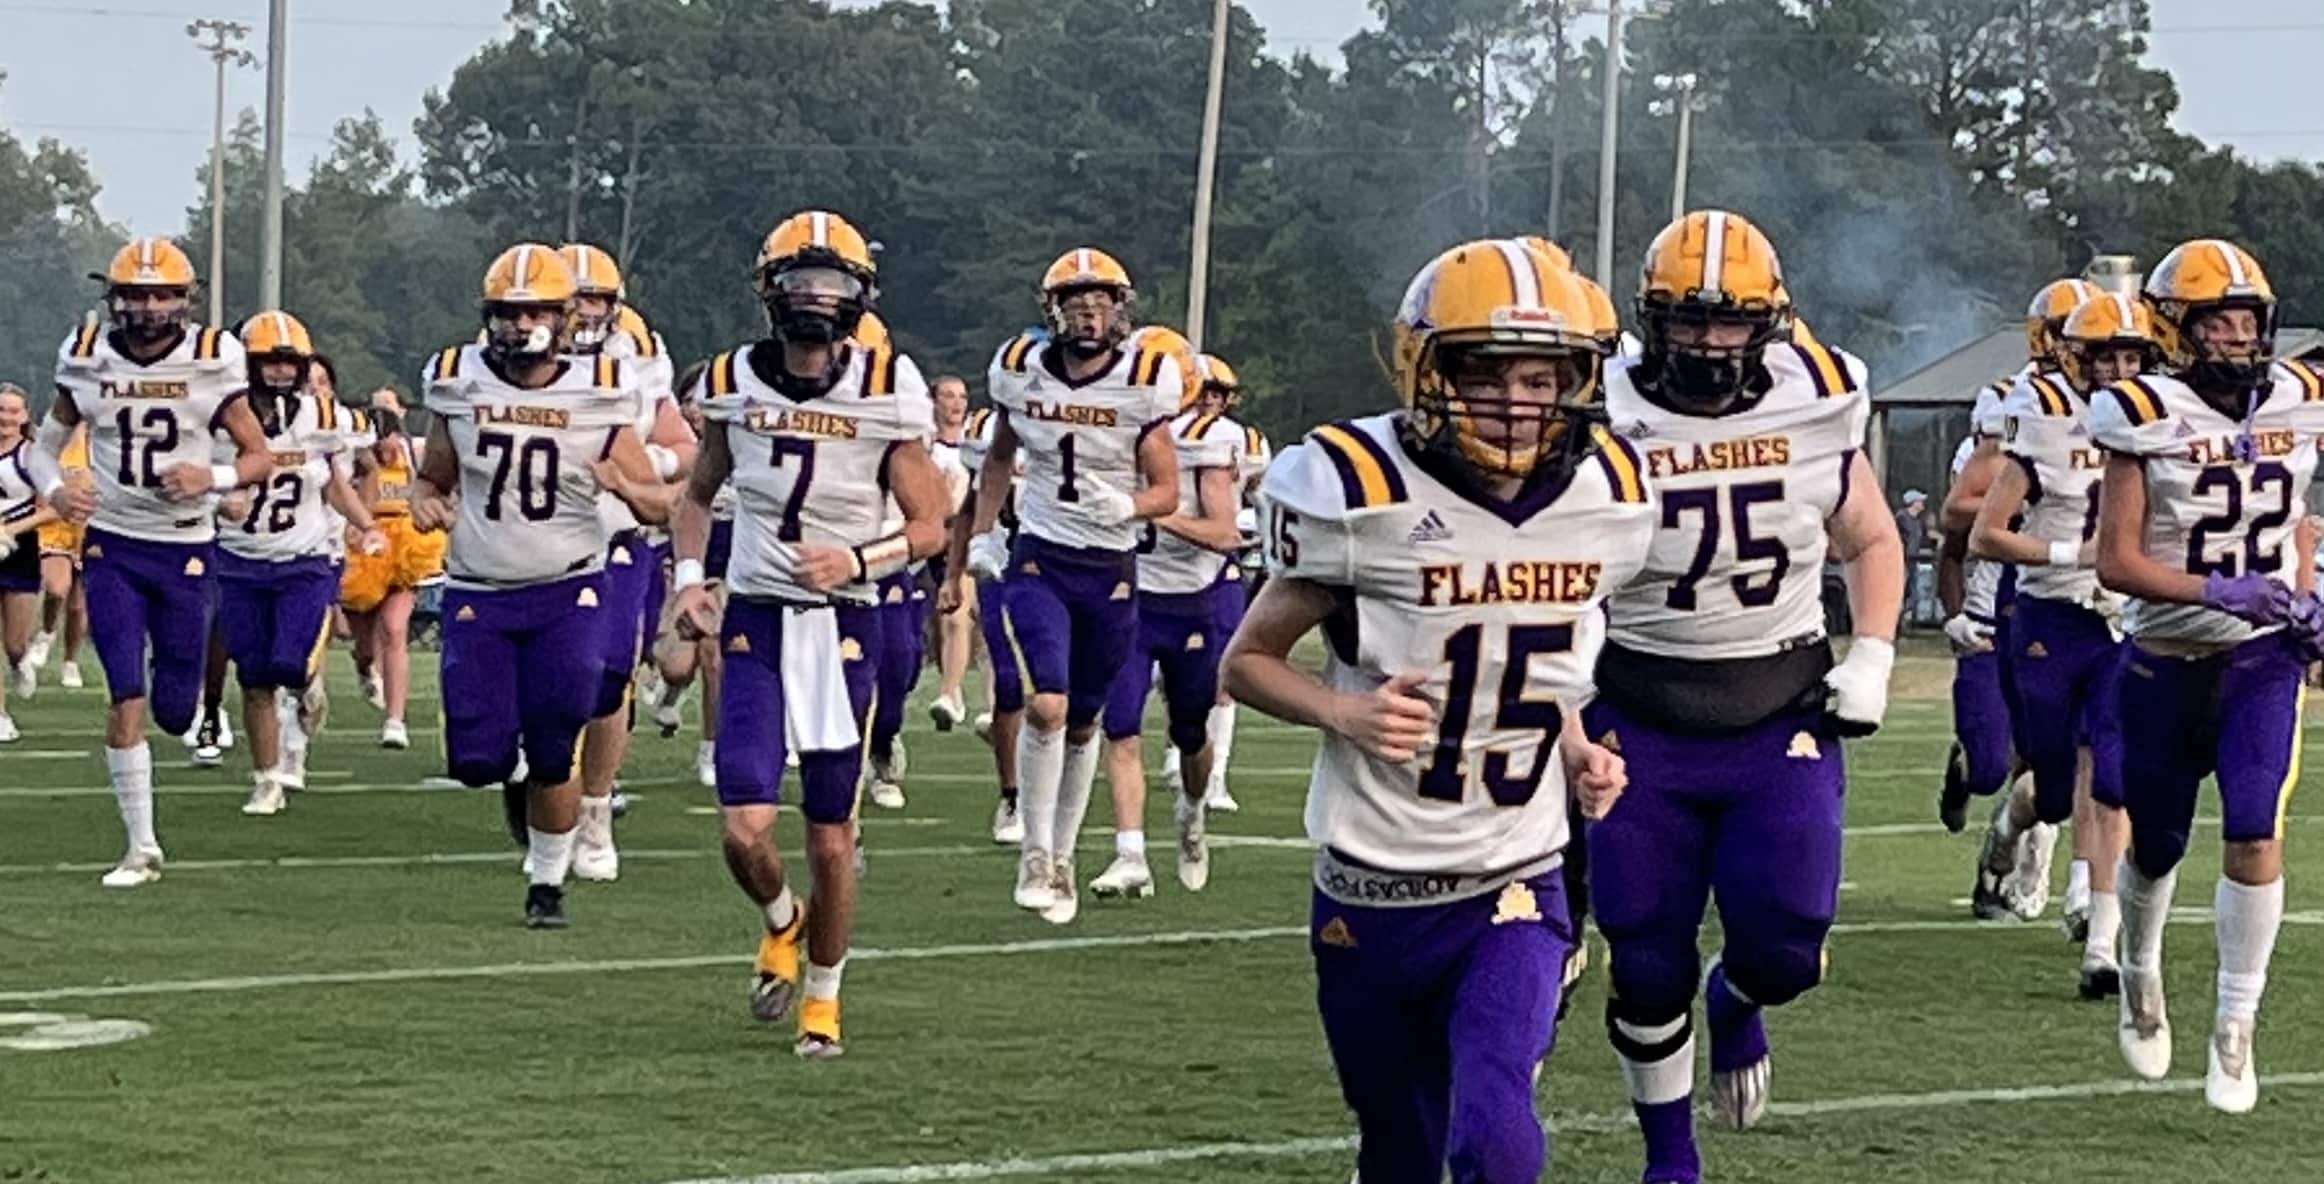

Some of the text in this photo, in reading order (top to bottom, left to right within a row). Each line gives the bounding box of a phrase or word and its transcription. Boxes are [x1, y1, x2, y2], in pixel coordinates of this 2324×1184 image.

[116, 405, 180, 488] 12
[473, 405, 570, 429] FLASHES
[744, 409, 858, 438] FLASHES
[1024, 401, 1117, 427] FLASHES
[475, 431, 560, 522] 70
[769, 435, 815, 542] 7
[1057, 431, 1079, 502] 1
[1646, 437, 1790, 477] FLASHES
[1270, 501, 1299, 568] 15
[1661, 479, 1790, 611] 75
[2186, 461, 2294, 577] 22
[1418, 561, 1602, 607] FLASHES
[1417, 622, 1577, 807] 15
